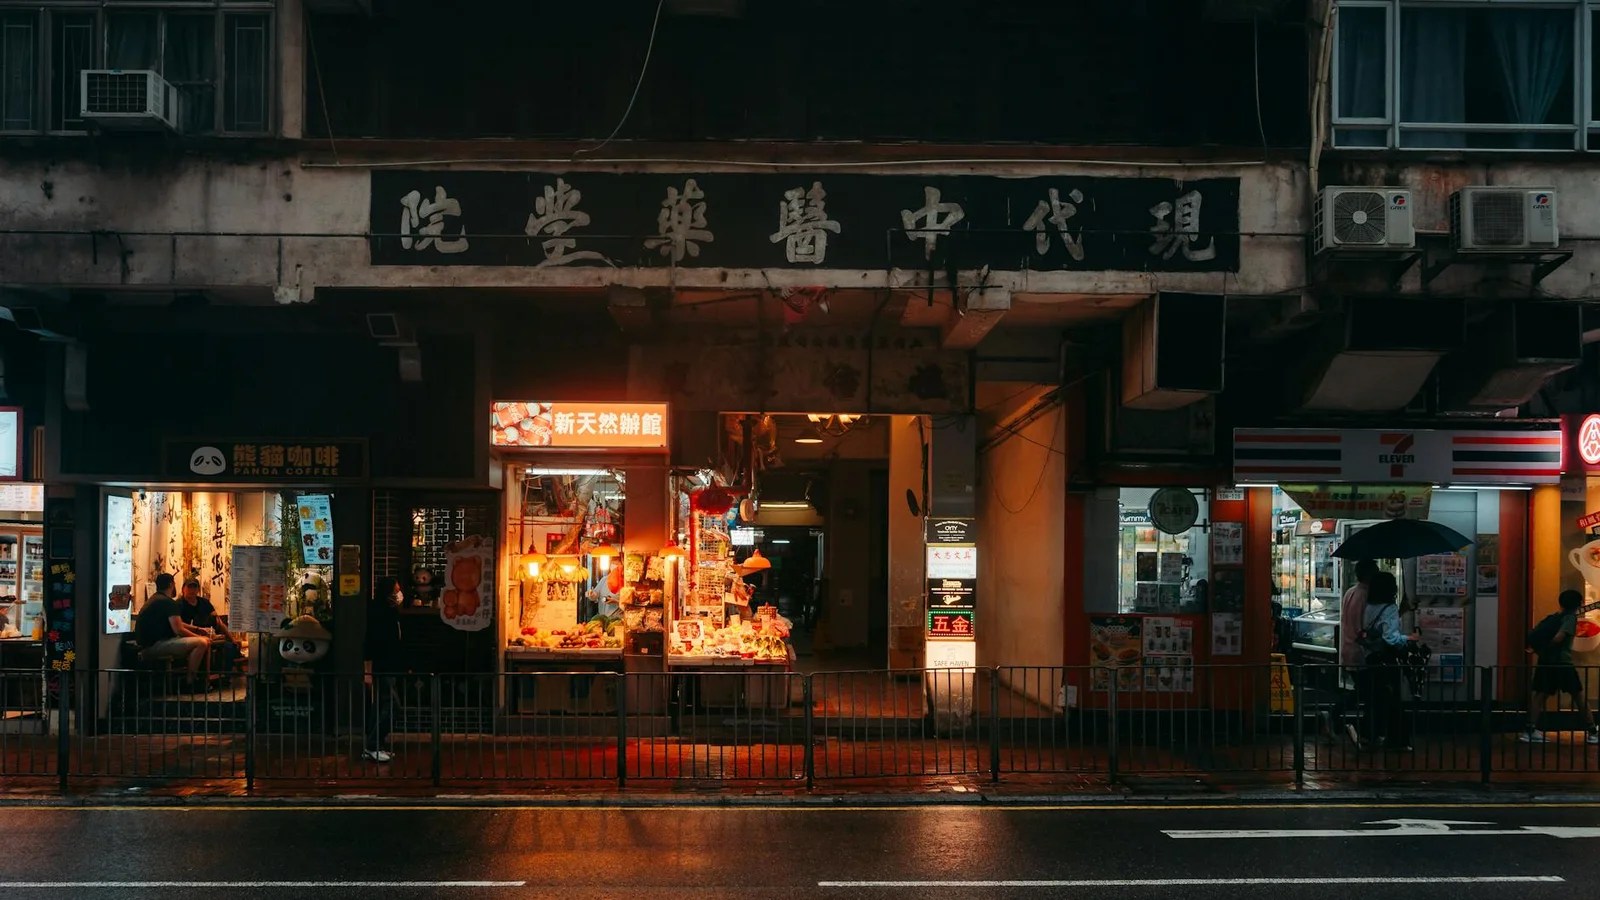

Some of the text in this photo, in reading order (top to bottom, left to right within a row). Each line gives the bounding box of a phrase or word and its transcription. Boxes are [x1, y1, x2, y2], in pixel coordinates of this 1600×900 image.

[554, 411, 662, 436] 新天然辦館
[232, 444, 339, 467] 熊貓咖啡
[233, 467, 338, 475] PANDA COFFEE
[1119, 515, 1147, 524] Yummy
[932, 615, 969, 633] 五金
